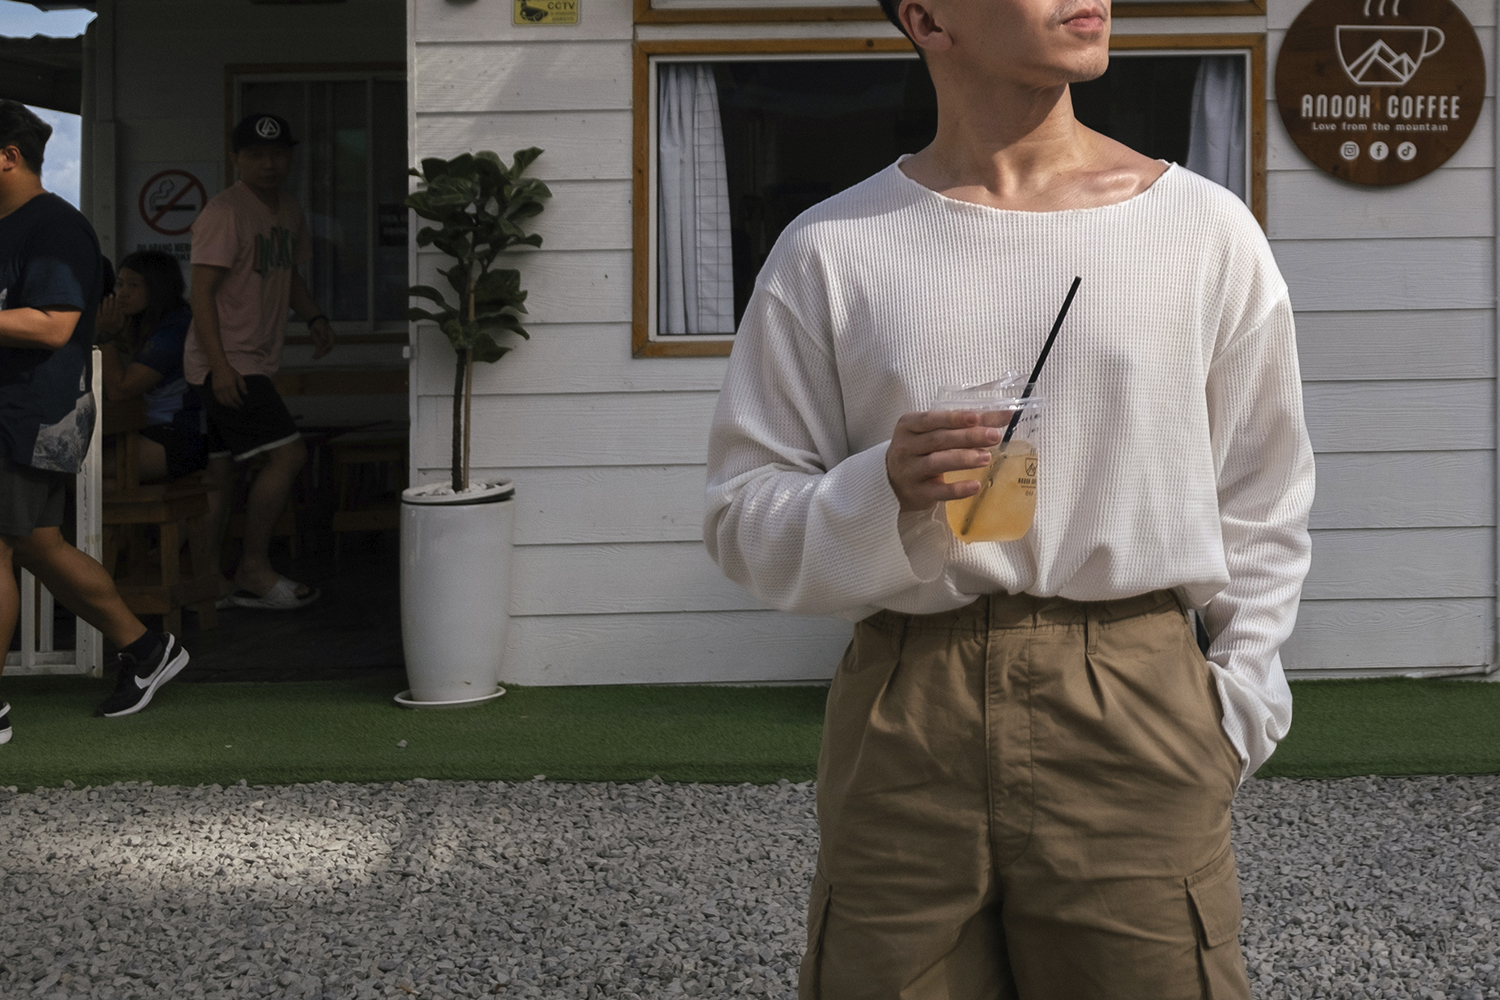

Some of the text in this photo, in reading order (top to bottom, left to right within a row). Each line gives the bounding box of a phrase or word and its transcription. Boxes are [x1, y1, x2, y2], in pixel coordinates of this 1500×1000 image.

[547, 1, 575, 10] CCTV
[1301, 94, 1460, 119] ANOOH COFFEE
[1312, 122, 1449, 132] Love from the mountain
